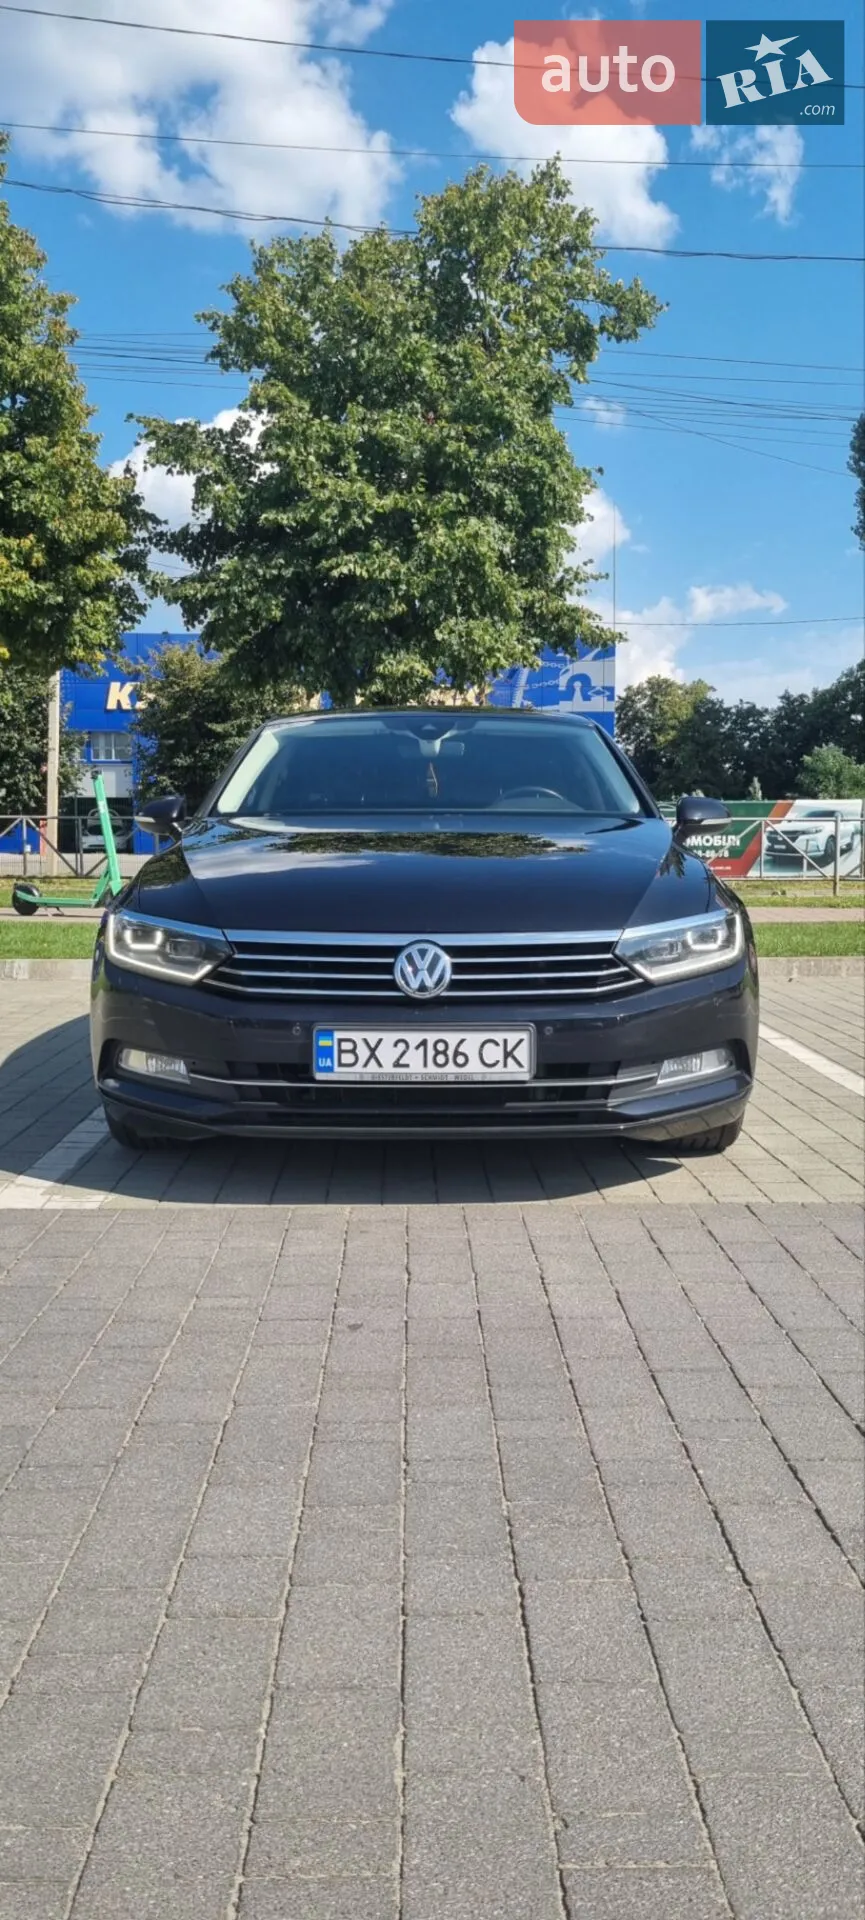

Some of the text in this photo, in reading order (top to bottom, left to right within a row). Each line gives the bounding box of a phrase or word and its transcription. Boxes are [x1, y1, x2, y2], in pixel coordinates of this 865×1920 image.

[318, 1057, 332, 1067] UA
[336, 1037, 525, 1069] BX 2186 CK
